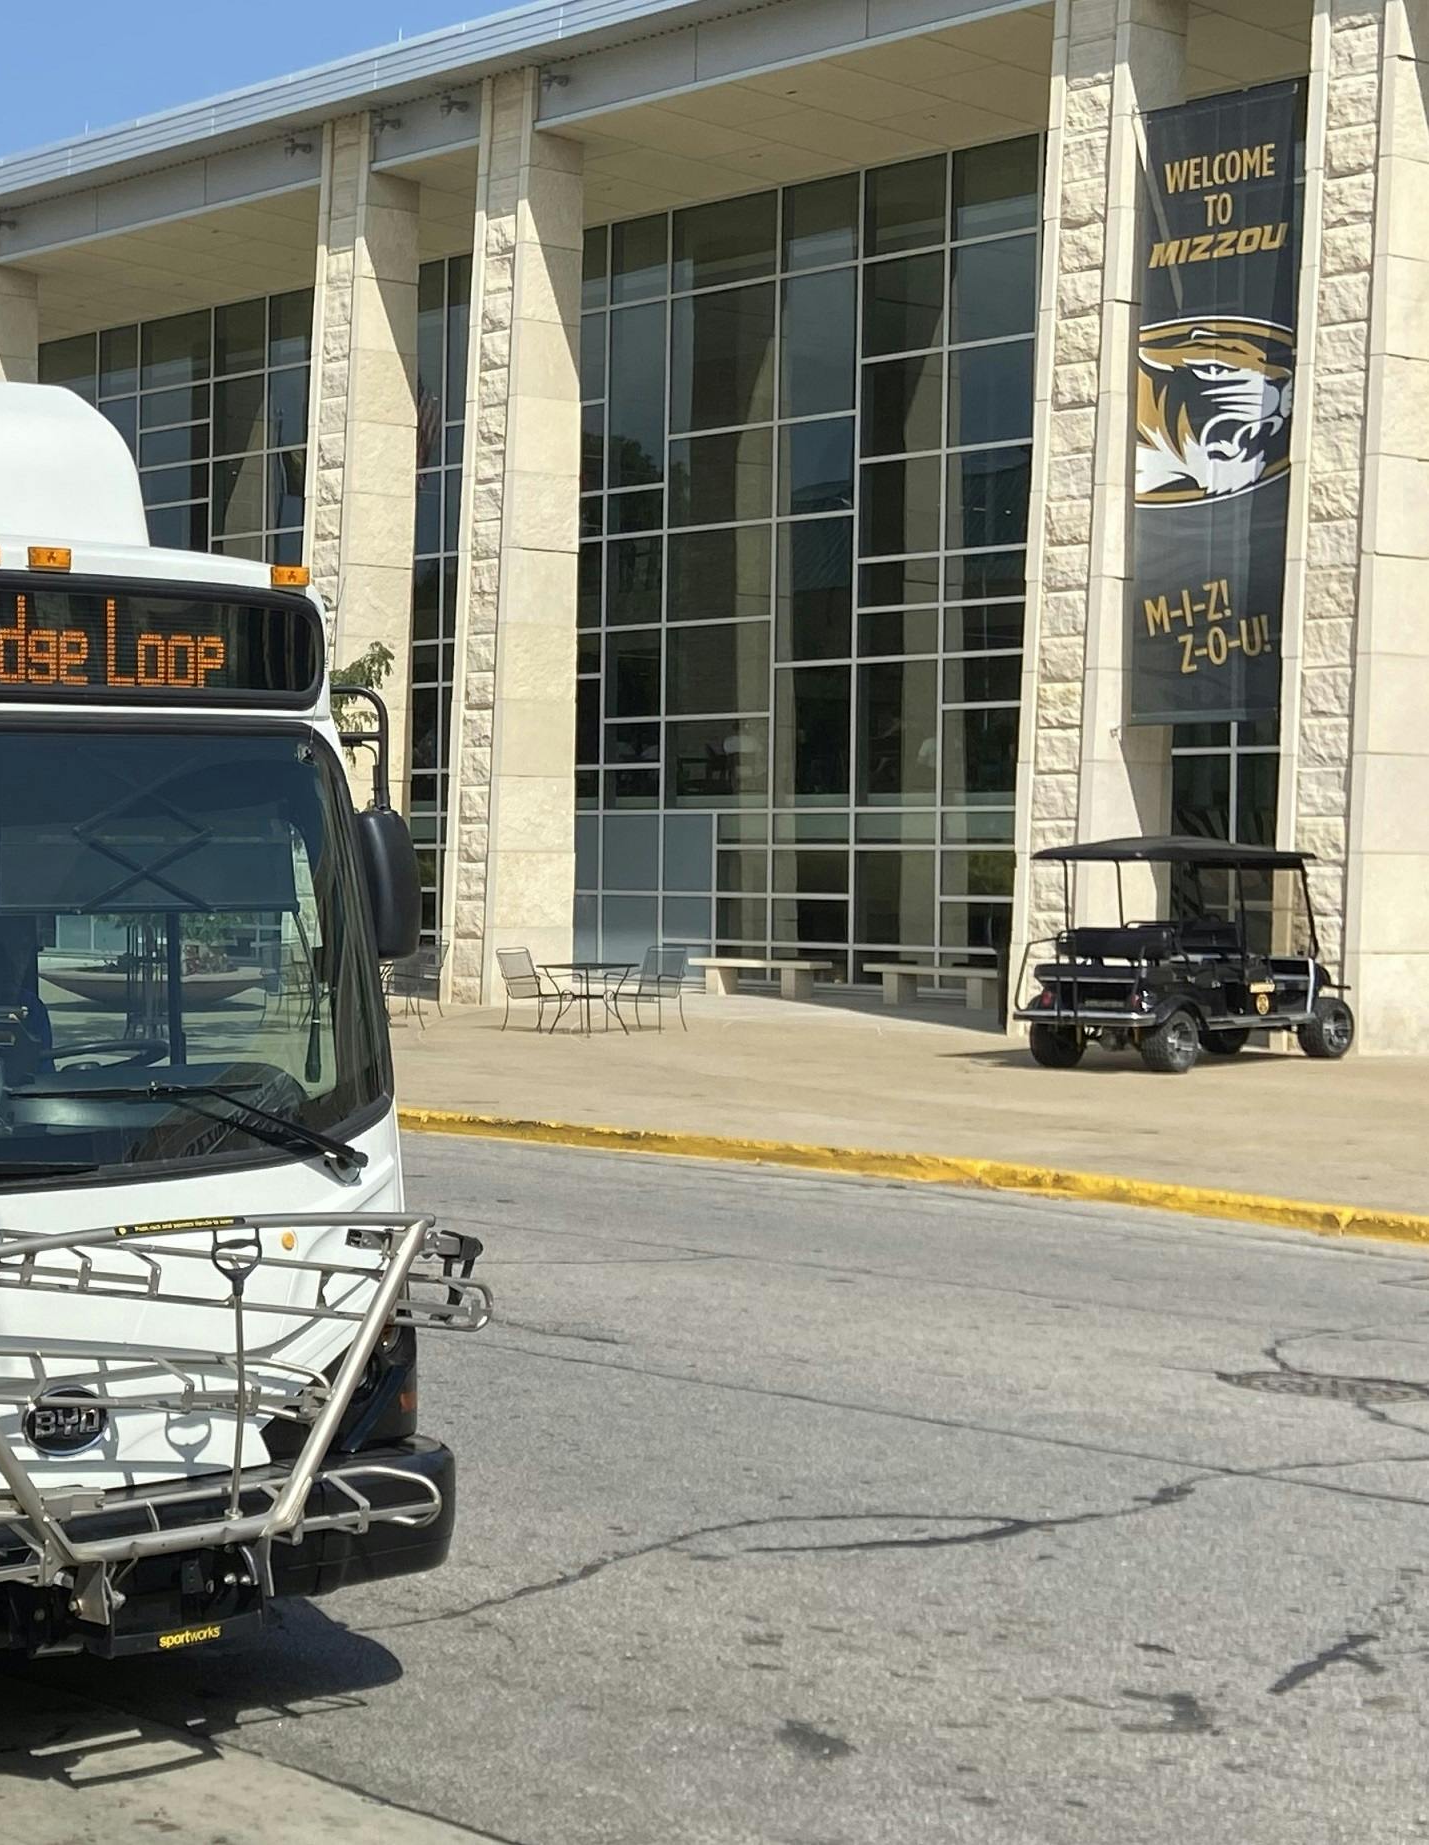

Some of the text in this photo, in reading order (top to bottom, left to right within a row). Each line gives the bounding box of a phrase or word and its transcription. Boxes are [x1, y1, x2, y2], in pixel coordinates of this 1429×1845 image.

[1164, 143, 1275, 194] WELCOME
[1203, 192, 1233, 227] TO
[1148, 222, 1288, 269] MIZZOU
[1143, 579, 1232, 637] M-I-Z!
[106, 598, 225, 688] Loop
[1178, 614, 1272, 674] Z-O-U!
[34, 1407, 101, 1439] BYD
[159, 1625, 221, 1648] sportworks
